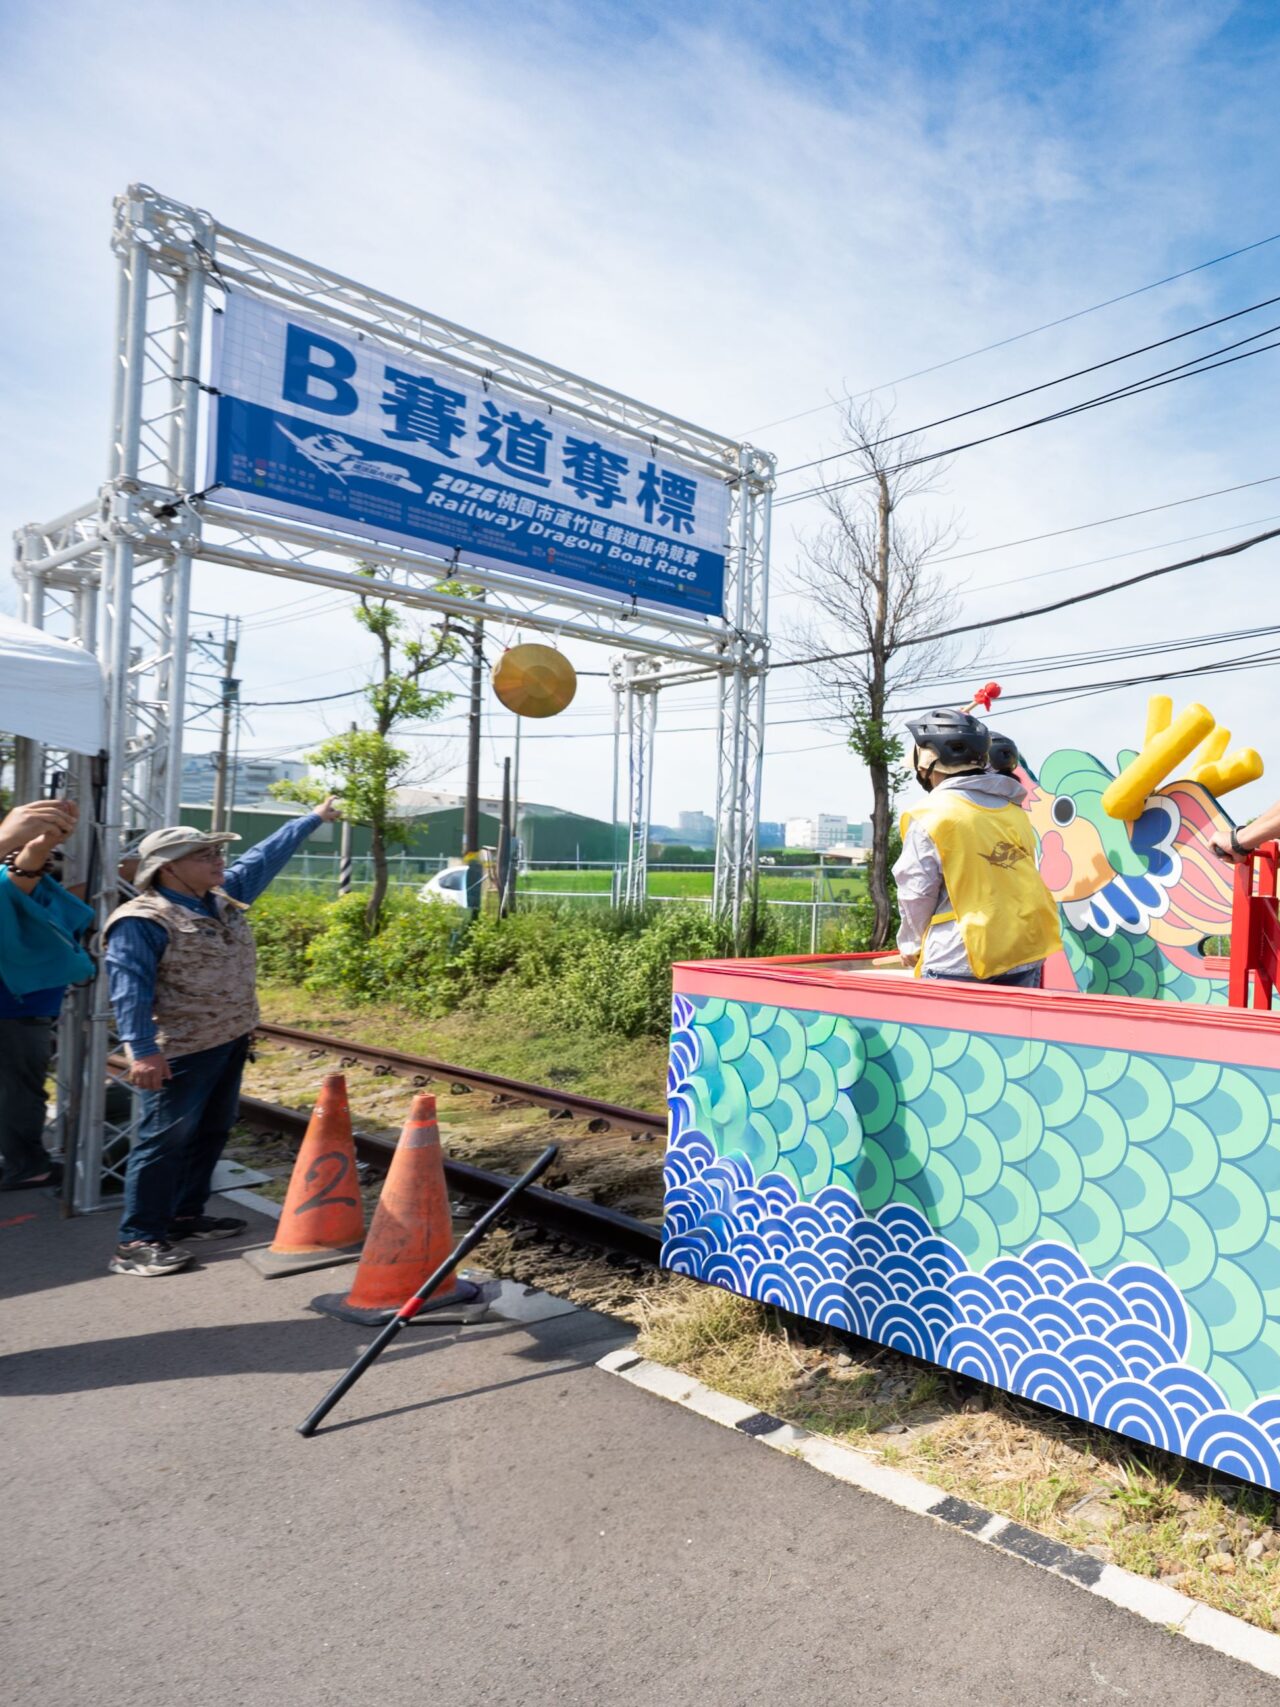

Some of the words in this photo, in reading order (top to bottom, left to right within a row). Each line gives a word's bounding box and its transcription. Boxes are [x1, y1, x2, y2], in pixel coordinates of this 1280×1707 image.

[282, 322, 697, 535] B賽道奪標
[427, 491, 524, 531] Railway
[528, 521, 604, 554] Dragon
[607, 545, 652, 571] Boat
[655, 560, 697, 582] Race
[432, 473, 699, 567] 2026桃園市蘆竹區鐵道龍舟競賽
[295, 1151, 356, 1215] 2
